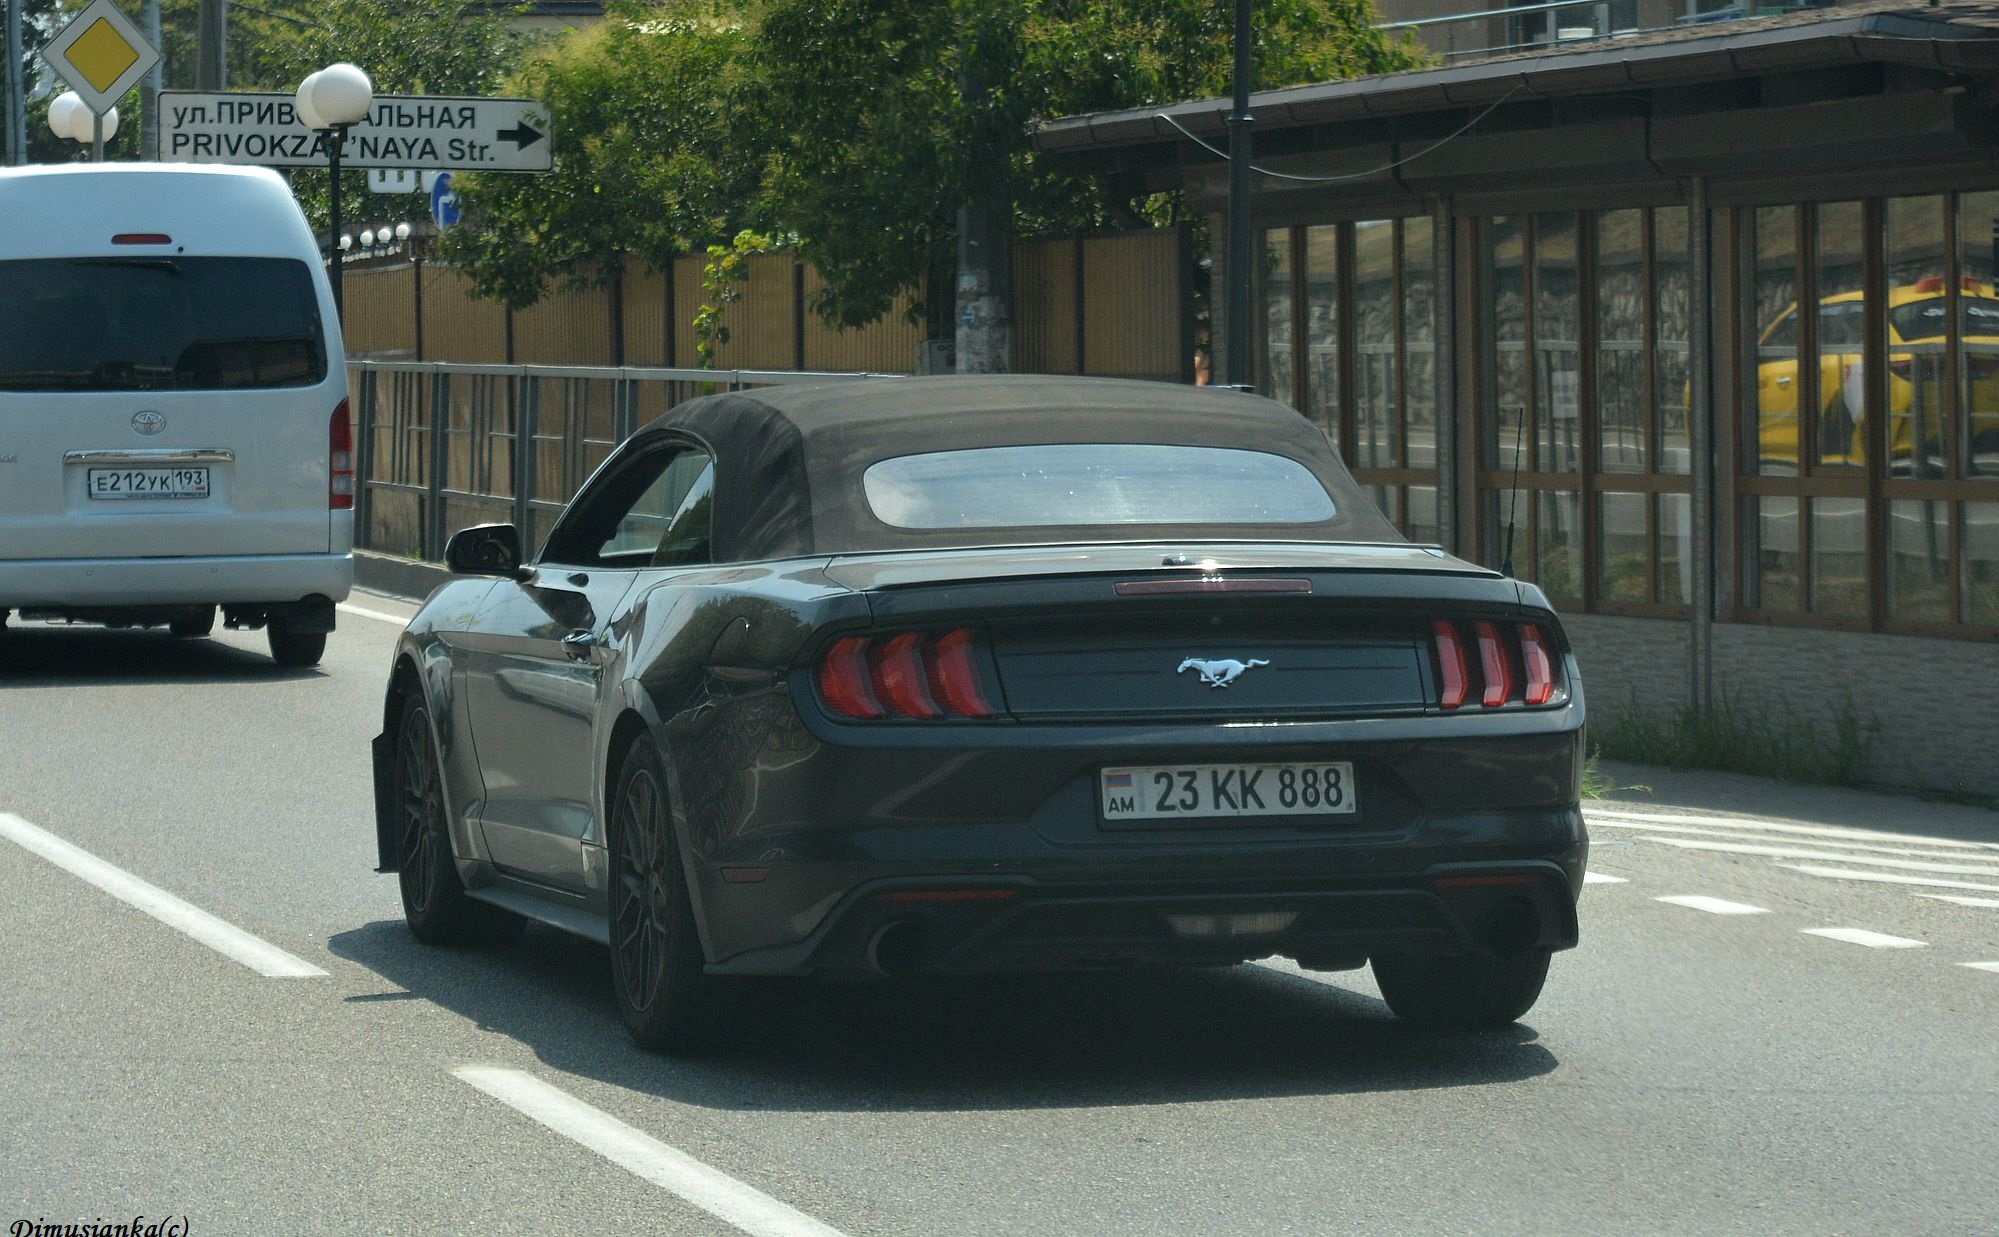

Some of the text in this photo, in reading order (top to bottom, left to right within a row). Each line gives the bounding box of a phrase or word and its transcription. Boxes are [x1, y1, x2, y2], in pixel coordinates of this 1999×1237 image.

[448, 138, 495, 161] Str.
[97, 471, 202, 491] Е212УК 193
[1108, 768, 1343, 813] AM 23 KK 888
